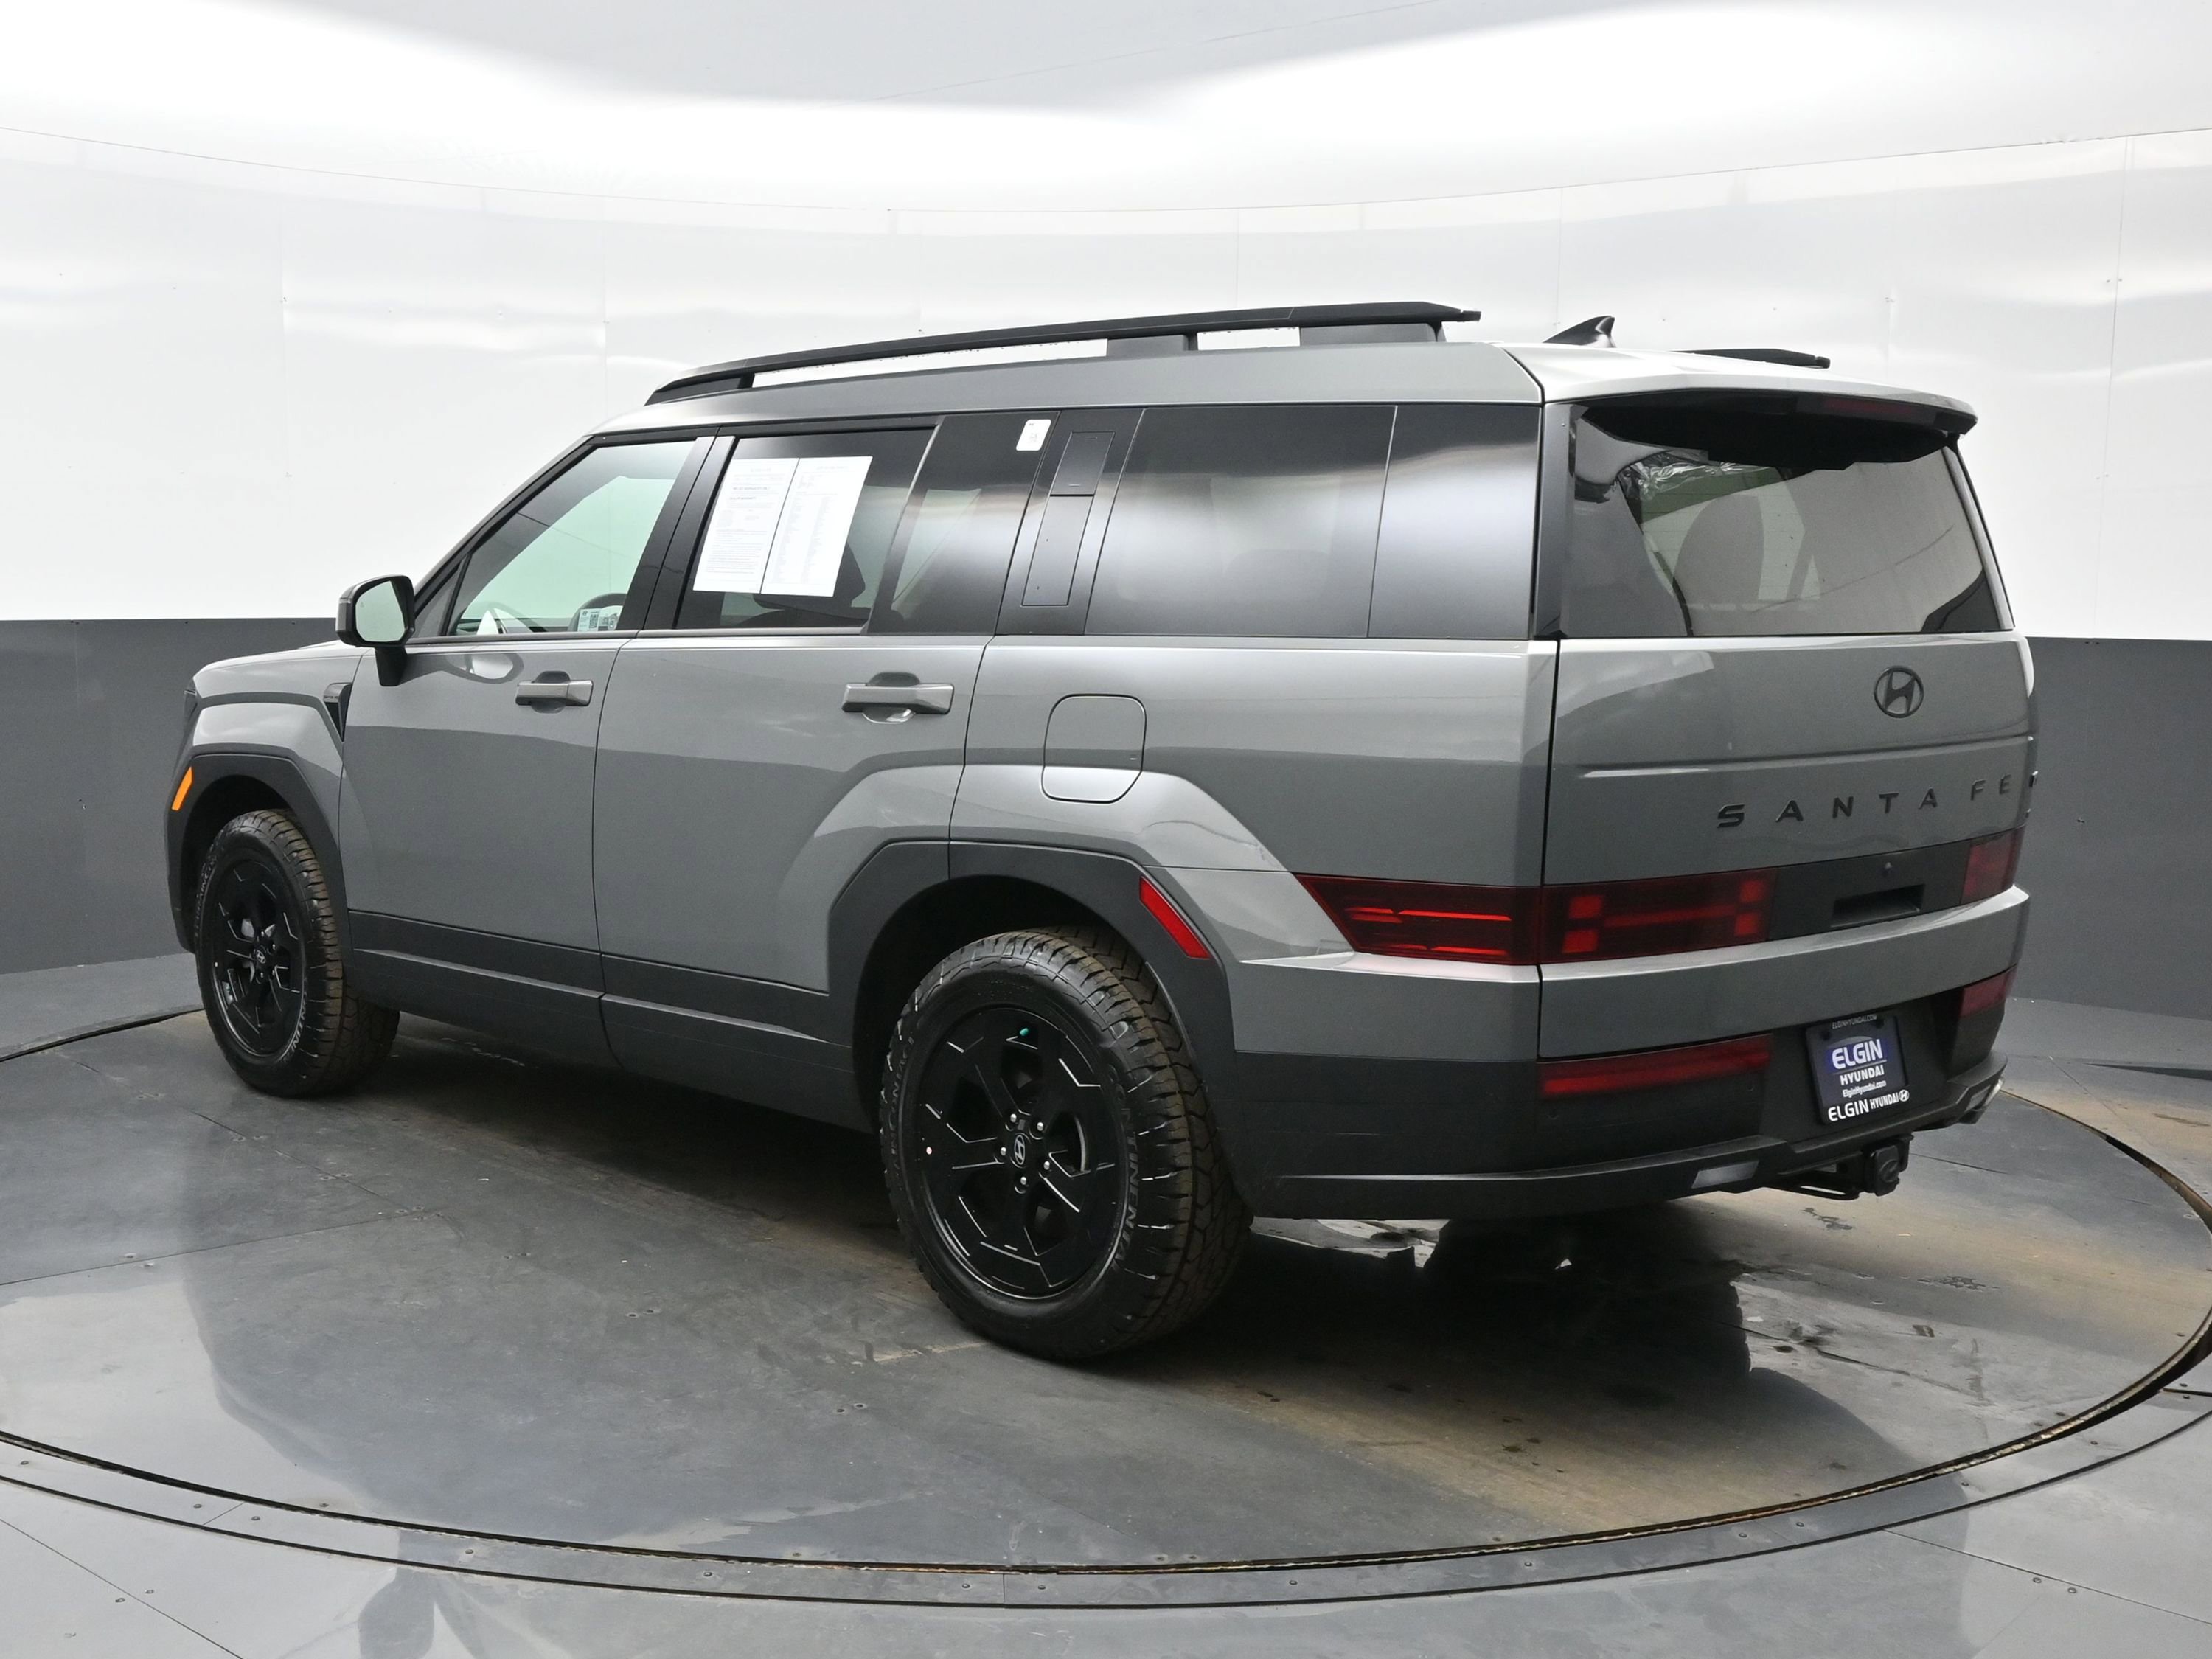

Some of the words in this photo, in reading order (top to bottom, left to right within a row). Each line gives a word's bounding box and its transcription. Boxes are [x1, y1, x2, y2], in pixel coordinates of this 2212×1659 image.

[1716, 787, 1939, 830] SANTA
[1969, 773, 2012, 801] FE
[1832, 1038, 1884, 1070] ELGIN
[1840, 1064, 1885, 1086] HYUNDAI
[1842, 1079, 1887, 1099] ElginHyundai.com
[1827, 1098, 1870, 1122] ELGIN
[1869, 1091, 1899, 1110] HYUNDAI
